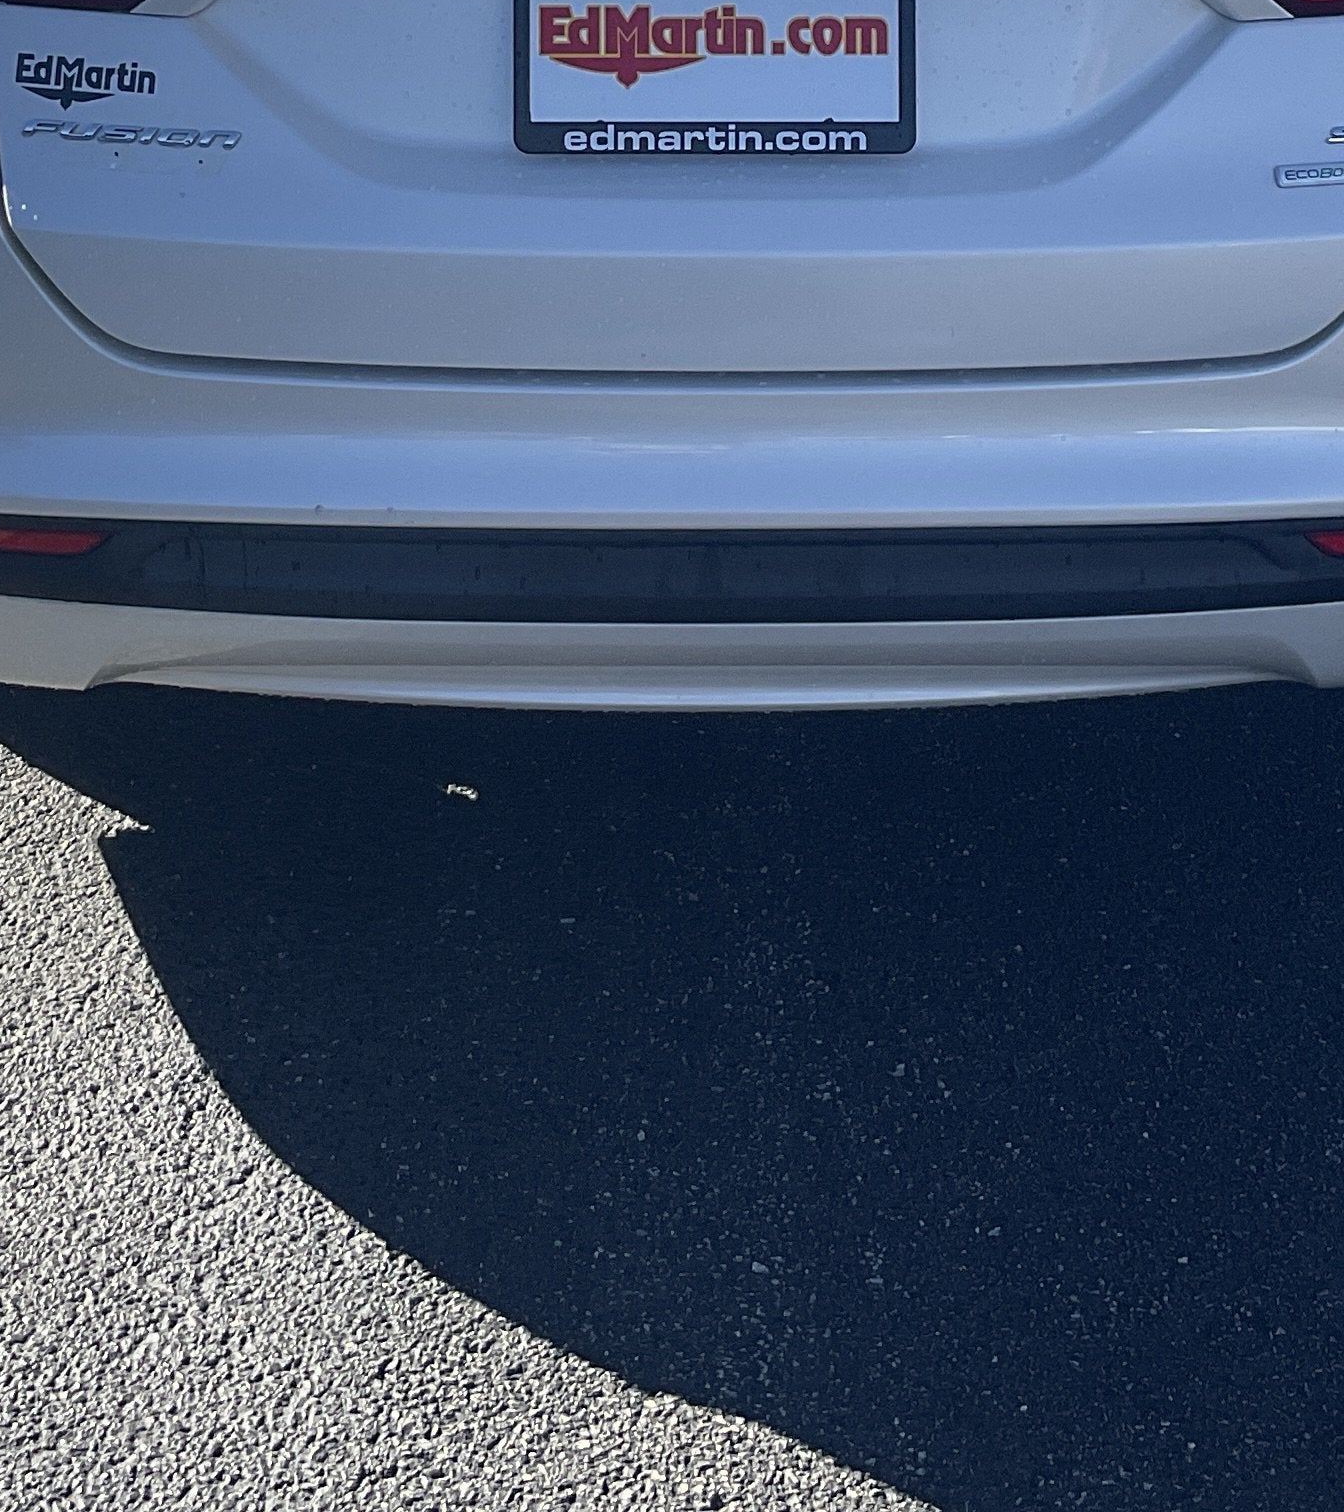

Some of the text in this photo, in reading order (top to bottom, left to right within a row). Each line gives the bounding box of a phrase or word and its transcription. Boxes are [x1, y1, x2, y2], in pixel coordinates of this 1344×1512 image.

[537, 4, 889, 60] EdMartin.com
[15, 52, 157, 96] EdMartin
[21, 118, 243, 150] FUSION
[562, 123, 868, 152] edmartin.com
